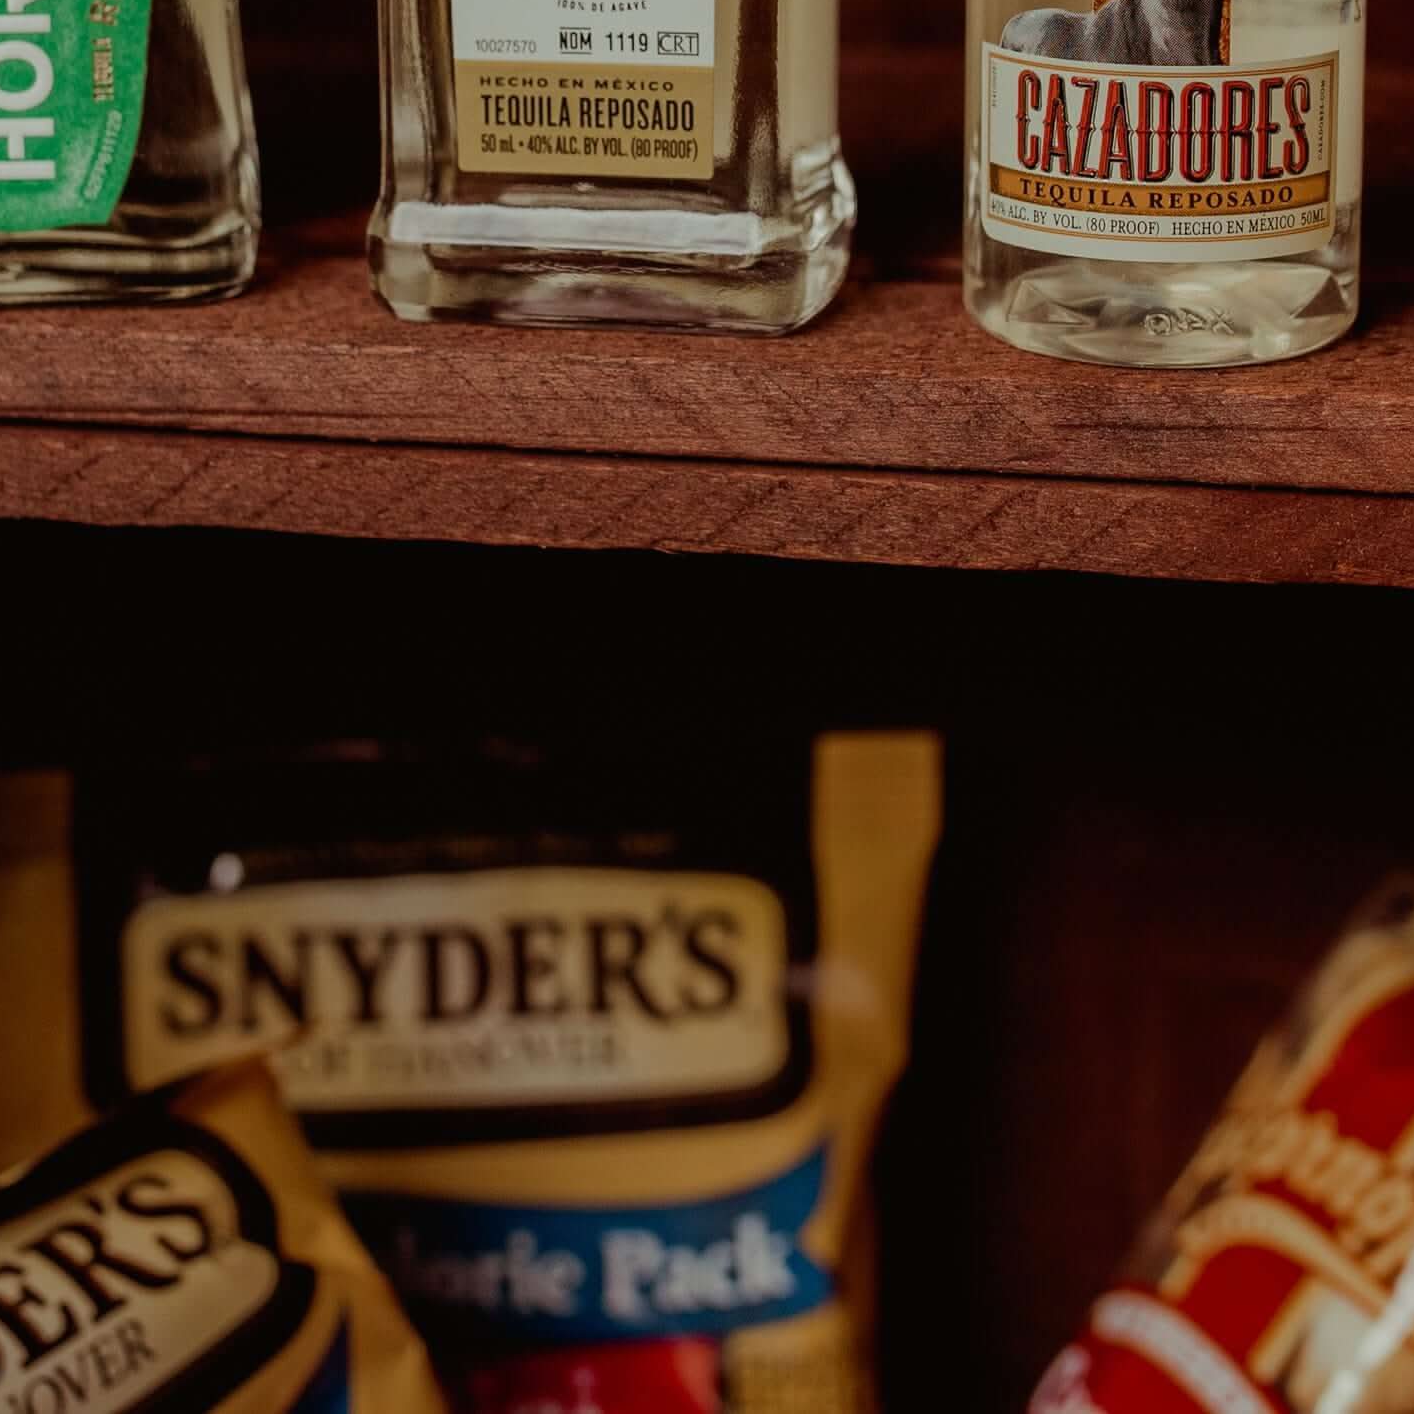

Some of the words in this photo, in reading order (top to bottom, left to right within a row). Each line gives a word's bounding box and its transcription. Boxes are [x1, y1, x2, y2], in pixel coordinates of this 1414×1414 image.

[591, 2, 605, 13] DE
[611, 1, 647, 12] AGAVE
[560, 31, 593, 51] NOM
[605, 32, 649, 52] 1119
[659, 34, 696, 53] CRT
[479, 76, 549, 89] HECHO
[559, 78, 584, 89] EN
[481, 94, 571, 128] TEQUILA
[579, 97, 695, 132] REPOSADO
[1015, 68, 1311, 184] CAZADORES
[481, 134, 498, 153] 50
[527, 135, 553, 155] 40%
[555, 135, 581, 156] ALC.
[585, 136, 599, 156] BY
[600, 137, 628, 157] VOL.
[631, 138, 651, 160] (80
[653, 138, 699, 163] PROOF)
[1019, 178, 1137, 209] TEQUILA
[1148, 186, 1295, 210] REPOSADO
[1007, 204, 1030, 222] ALC.
[1032, 209, 1047, 225] BY
[1053, 213, 1082, 230] VOL.
[1085, 216, 1106, 234] (80
[1110, 219, 1160, 236] PROOF)
[1172, 222, 1224, 236] HECHO
[1226, 220, 1245, 235] EN
[1300, 208, 1327, 226] 50ML
[159, 904, 741, 1035] SNYDER'S
[597, 1211, 799, 1323] Pack
[4, 1319, 160, 1414] OVER
